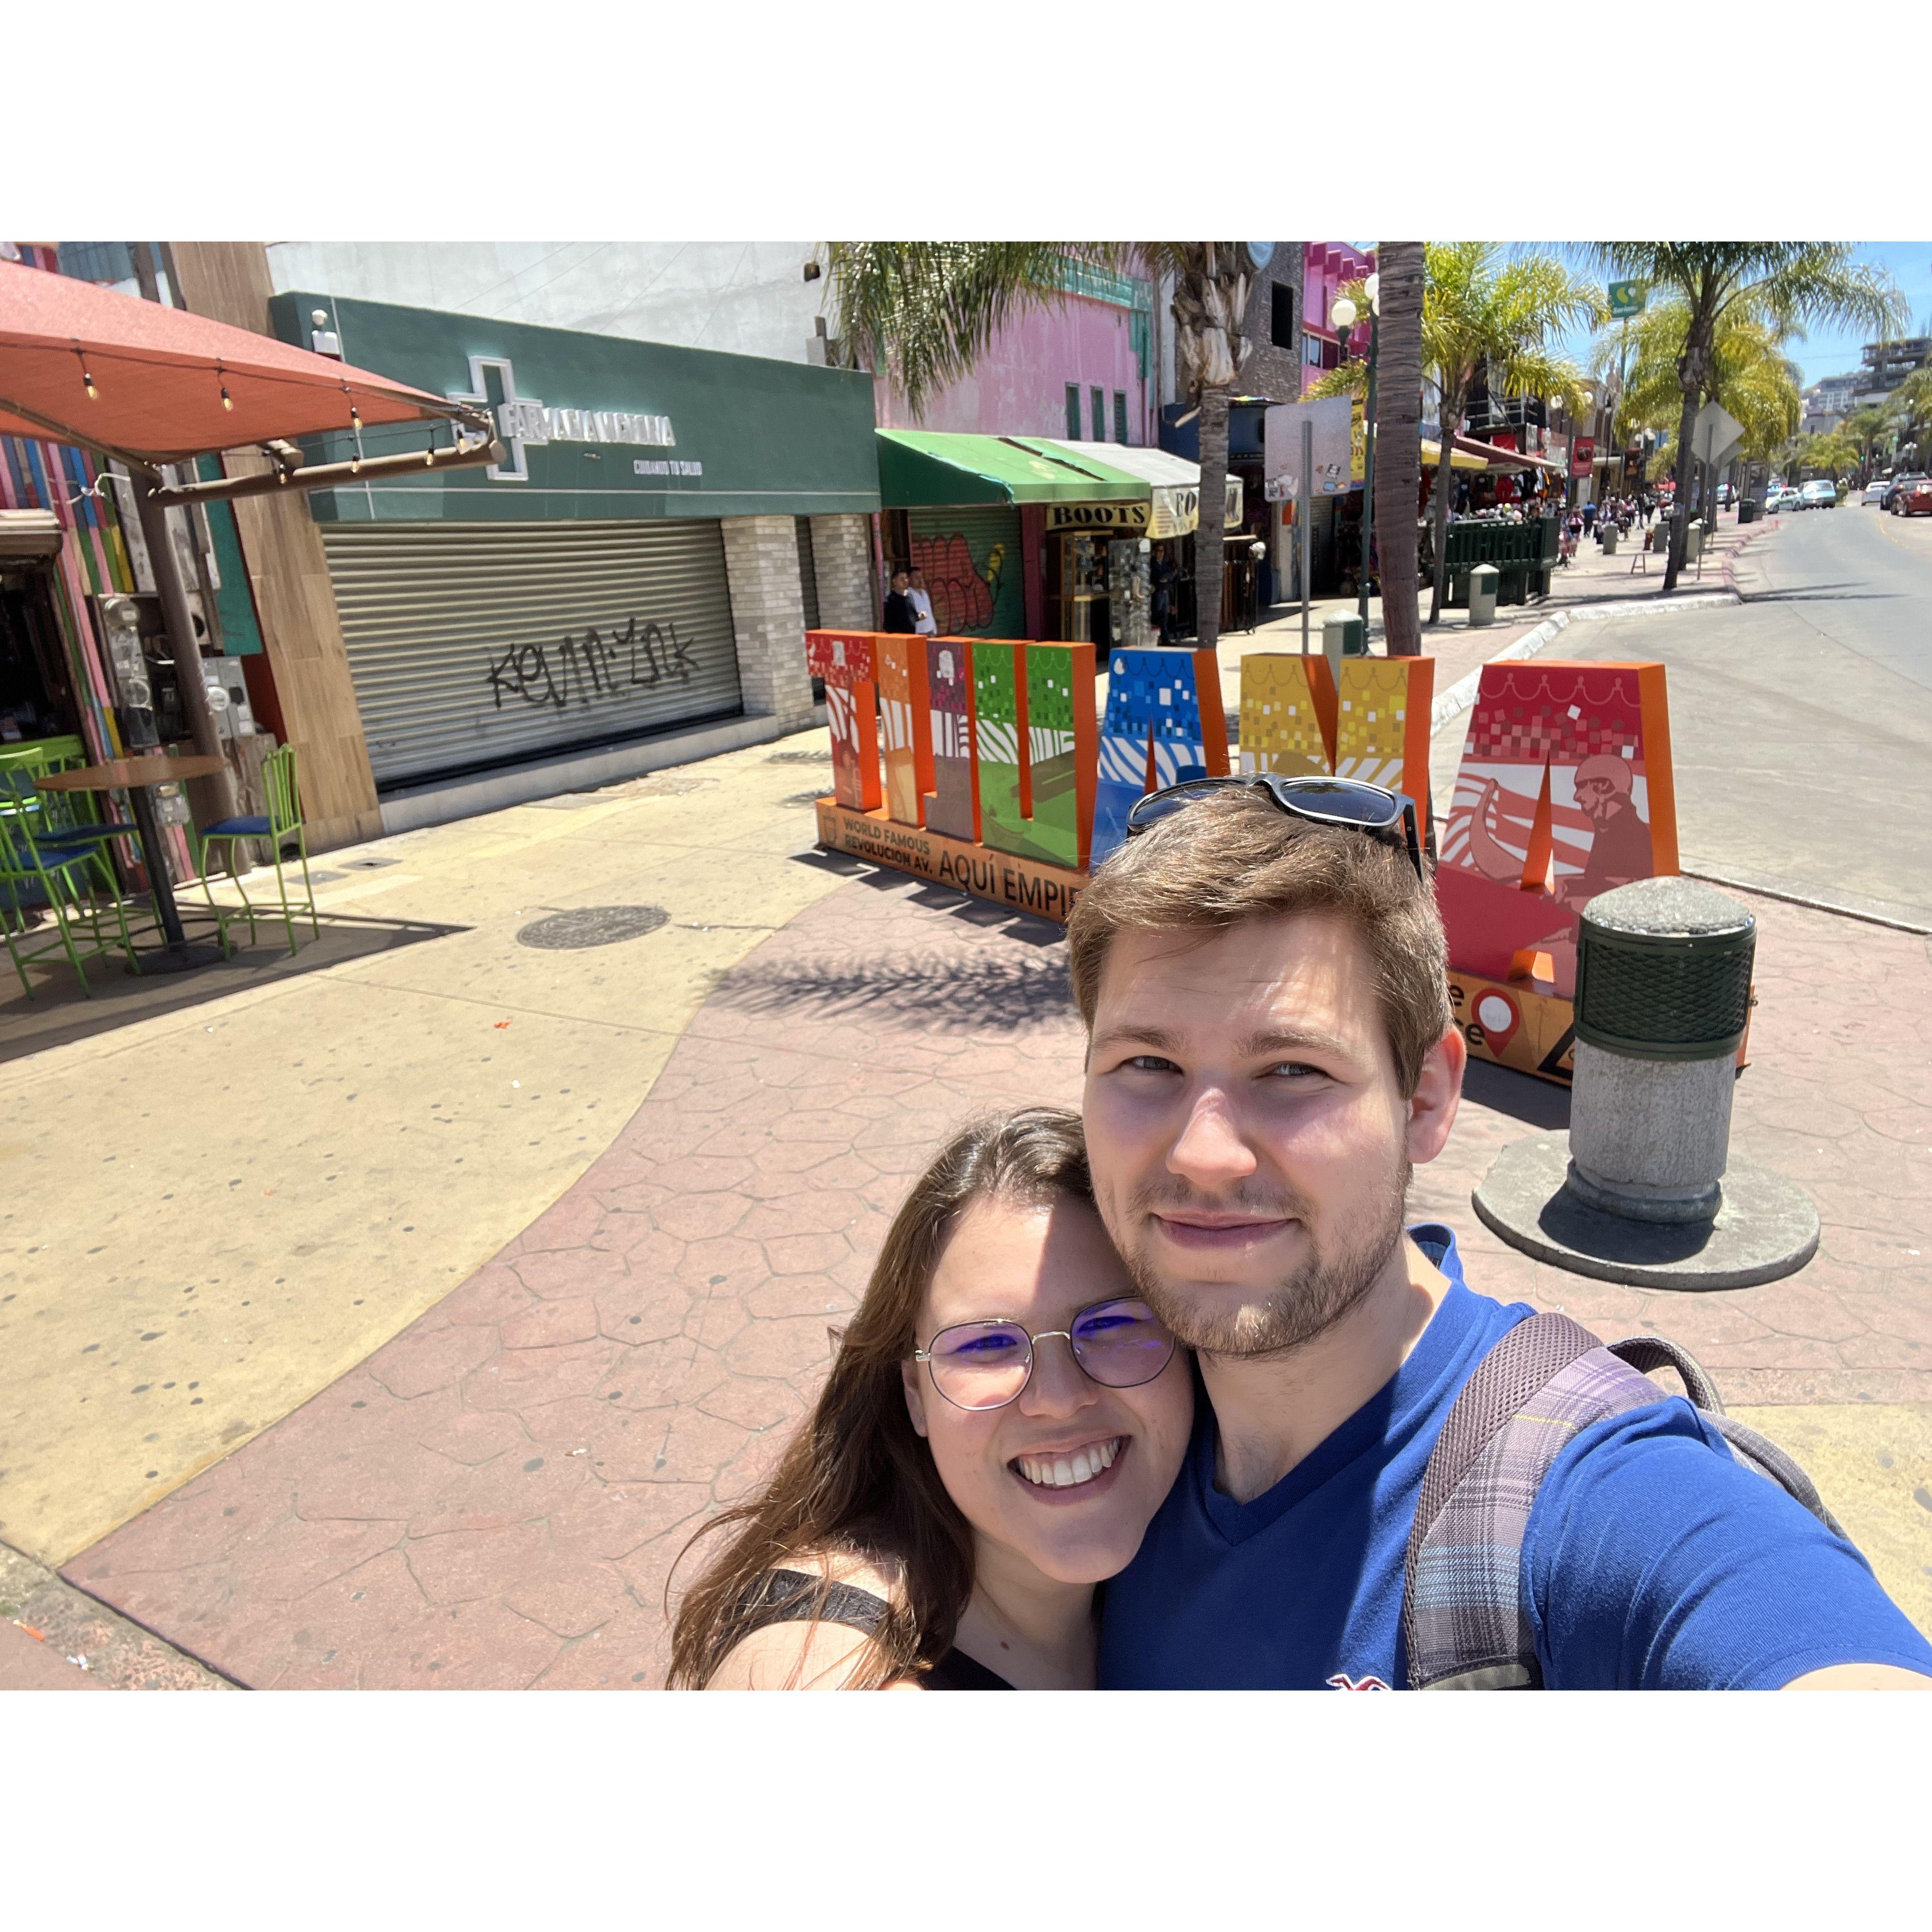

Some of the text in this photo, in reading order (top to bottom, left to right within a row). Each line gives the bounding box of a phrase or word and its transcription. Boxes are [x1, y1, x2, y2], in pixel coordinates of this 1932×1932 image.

[1055, 506, 1145, 526] BOOTS
[844, 817, 930, 855] WORLD FAMOUS
[914, 856, 933, 874] AV.
[939, 850, 995, 894] AQUÍ
